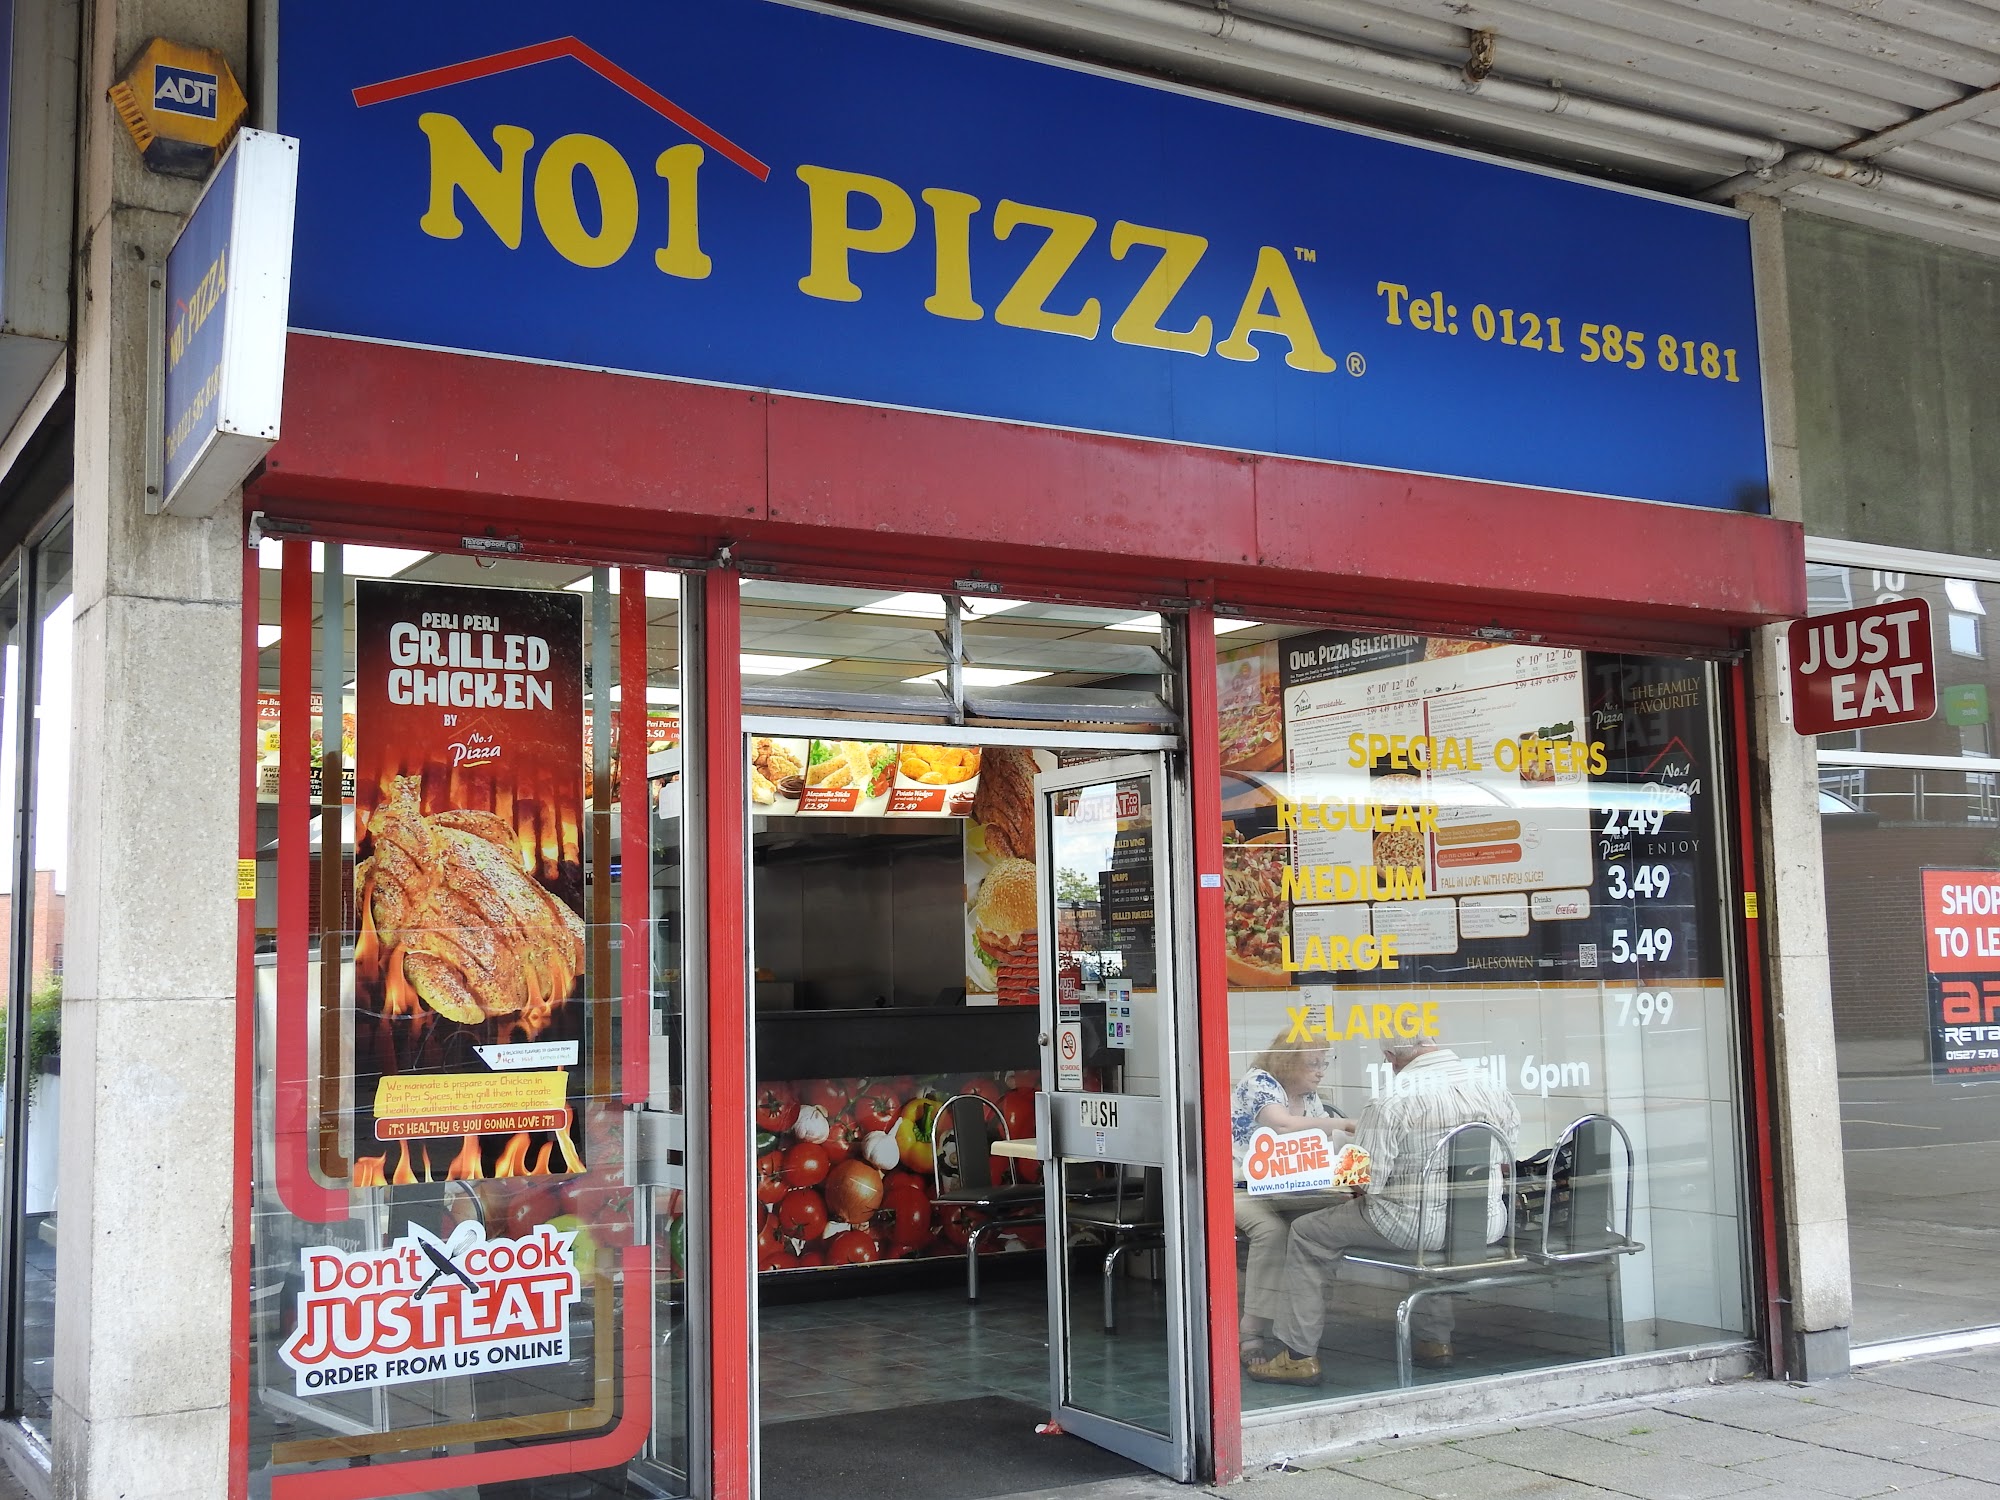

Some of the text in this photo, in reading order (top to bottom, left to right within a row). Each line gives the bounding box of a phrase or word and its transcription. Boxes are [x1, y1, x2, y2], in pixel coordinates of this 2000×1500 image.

[155, 76, 217, 109] ADT
[417, 112, 1338, 374] NO1 PIZZA
[187, 248, 226, 345] PIZZA
[1376, 281, 1740, 383] Tel: 0121 585 8181
[421, 612, 500, 632] PERI PERI
[389, 621, 551, 672] GRILLED
[1318, 643, 1350, 665] PIZZA
[1351, 633, 1420, 658] SELECTION
[1799, 609, 1920, 675] JUST
[1529, 652, 1543, 666] 10"
[1545, 650, 1559, 663] 12"
[387, 668, 553, 711] CHICKEN
[1530, 678, 1543, 688] 4.49
[1563, 673, 1576, 682] 8.99
[1631, 676, 1701, 700] THE FAMILY
[1830, 662, 1924, 722] EAT
[1633, 692, 1700, 716] FAVOURITE
[443, 713, 458, 727] BY
[1592, 709, 1624, 730] Pizza
[466, 732, 494, 746] No.1
[448, 742, 501, 768] Pizza
[1347, 732, 1482, 772] SPECIAL
[1494, 740, 1609, 777] OFFERS
[1661, 762, 1691, 783] No.1
[803, 802, 829, 811] £2.99
[893, 802, 918, 811] £2.49
[1275, 796, 1441, 834] REGULAR
[1600, 802, 1665, 836] 2.49
[1598, 838, 1631, 860] Pizza
[1648, 839, 1700, 856] ENJOY
[1280, 864, 1428, 902] MEDIUM
[1440, 877, 1455, 889] FALL
[1464, 875, 1481, 887] LOVE
[1501, 872, 1522, 885] EVERY
[1607, 864, 1671, 900] 3.49
[1534, 896, 1552, 904] Drinks
[1281, 933, 1400, 972] LARGE
[1612, 927, 1673, 964] 5.49
[1935, 927, 1969, 958] TO
[1466, 955, 1534, 970] HALESOWEN
[1285, 1001, 1441, 1044] X-LARGE
[1614, 991, 1674, 1028] 7.99
[1946, 1048, 1999, 1061] 01527 578
[386, 1081, 402, 1091] We
[404, 1078, 441, 1090] marinate
[452, 1079, 483, 1093] prepare
[484, 1079, 498, 1087] our
[500, 1076, 533, 1087] Chicken
[535, 1077, 543, 1085] in
[1365, 1061, 1449, 1099] 11am
[1520, 1054, 1591, 1099] 6pm
[386, 1087, 552, 1104] Peri Peri Spices, then grill them to create
[386, 1103, 418, 1115] healthy,
[421, 1102, 460, 1113] authentic
[471, 1099, 518, 1111] flavoursome
[406, 1121, 450, 1135] HEALTHY
[462, 1119, 482, 1132] YOU
[483, 1117, 516, 1130] GONNA
[517, 1115, 540, 1129] LOVE
[1081, 1100, 1118, 1128] PUSH
[1254, 1133, 1323, 1159] ORDER
[1248, 1149, 1330, 1181] ONLINE
[1251, 1178, 1332, 1193] www.no1pizza.com
[309, 1231, 567, 1293] Don't cook
[297, 1279, 568, 1358] JUST EAT
[305, 1339, 564, 1388] ORDER FROM US ONLINE
